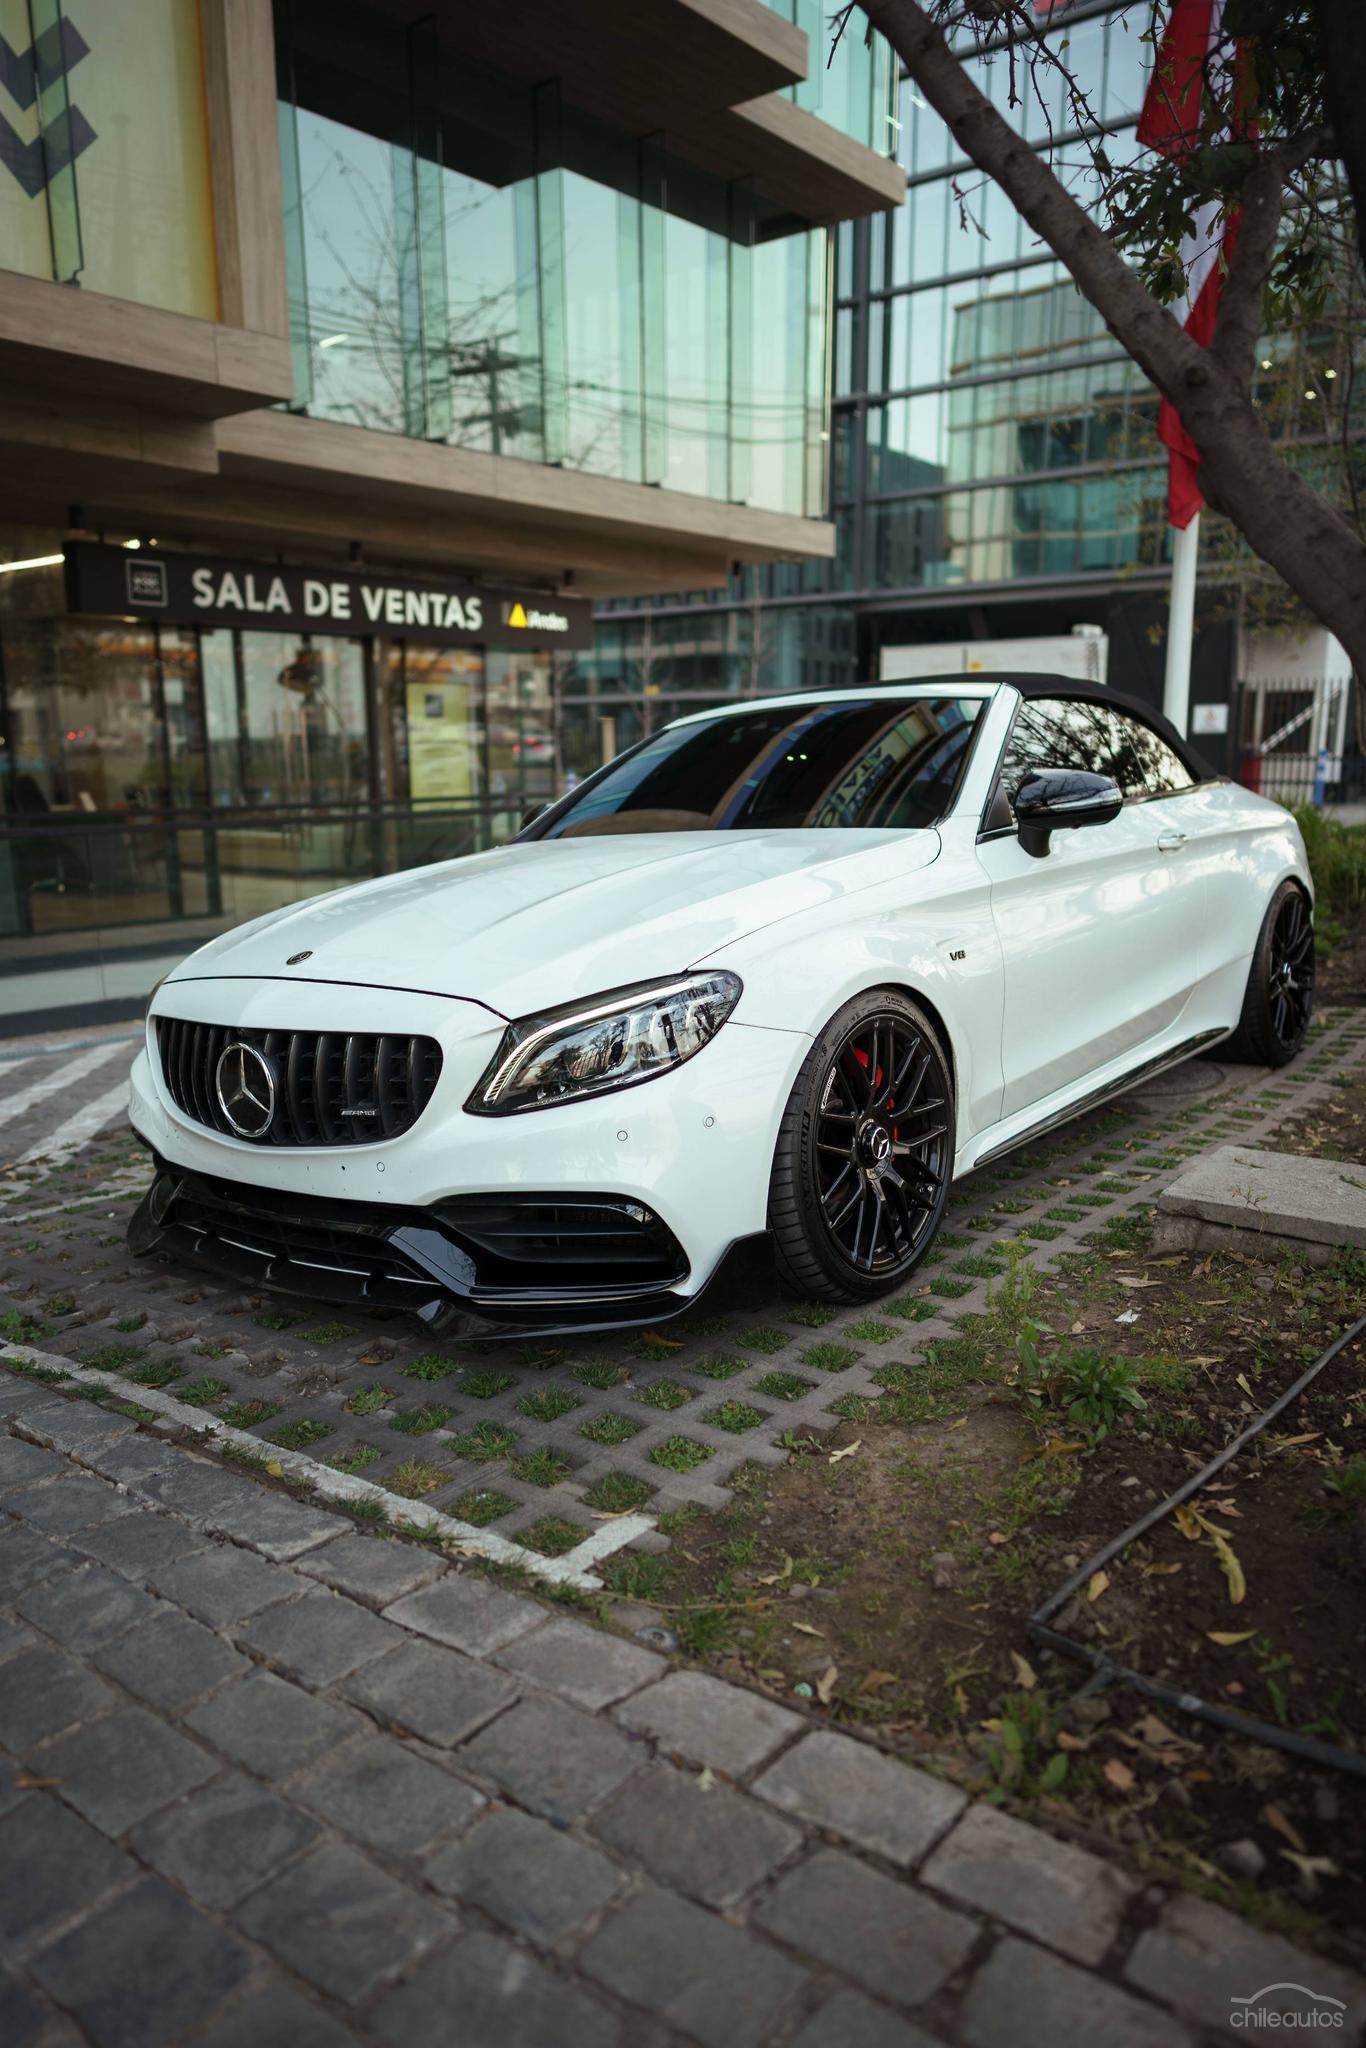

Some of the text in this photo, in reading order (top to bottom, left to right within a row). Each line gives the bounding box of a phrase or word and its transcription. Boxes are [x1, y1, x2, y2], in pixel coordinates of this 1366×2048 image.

[192, 568, 292, 614] SALA
[303, 579, 351, 619] DE
[360, 585, 483, 631] VENTAS
